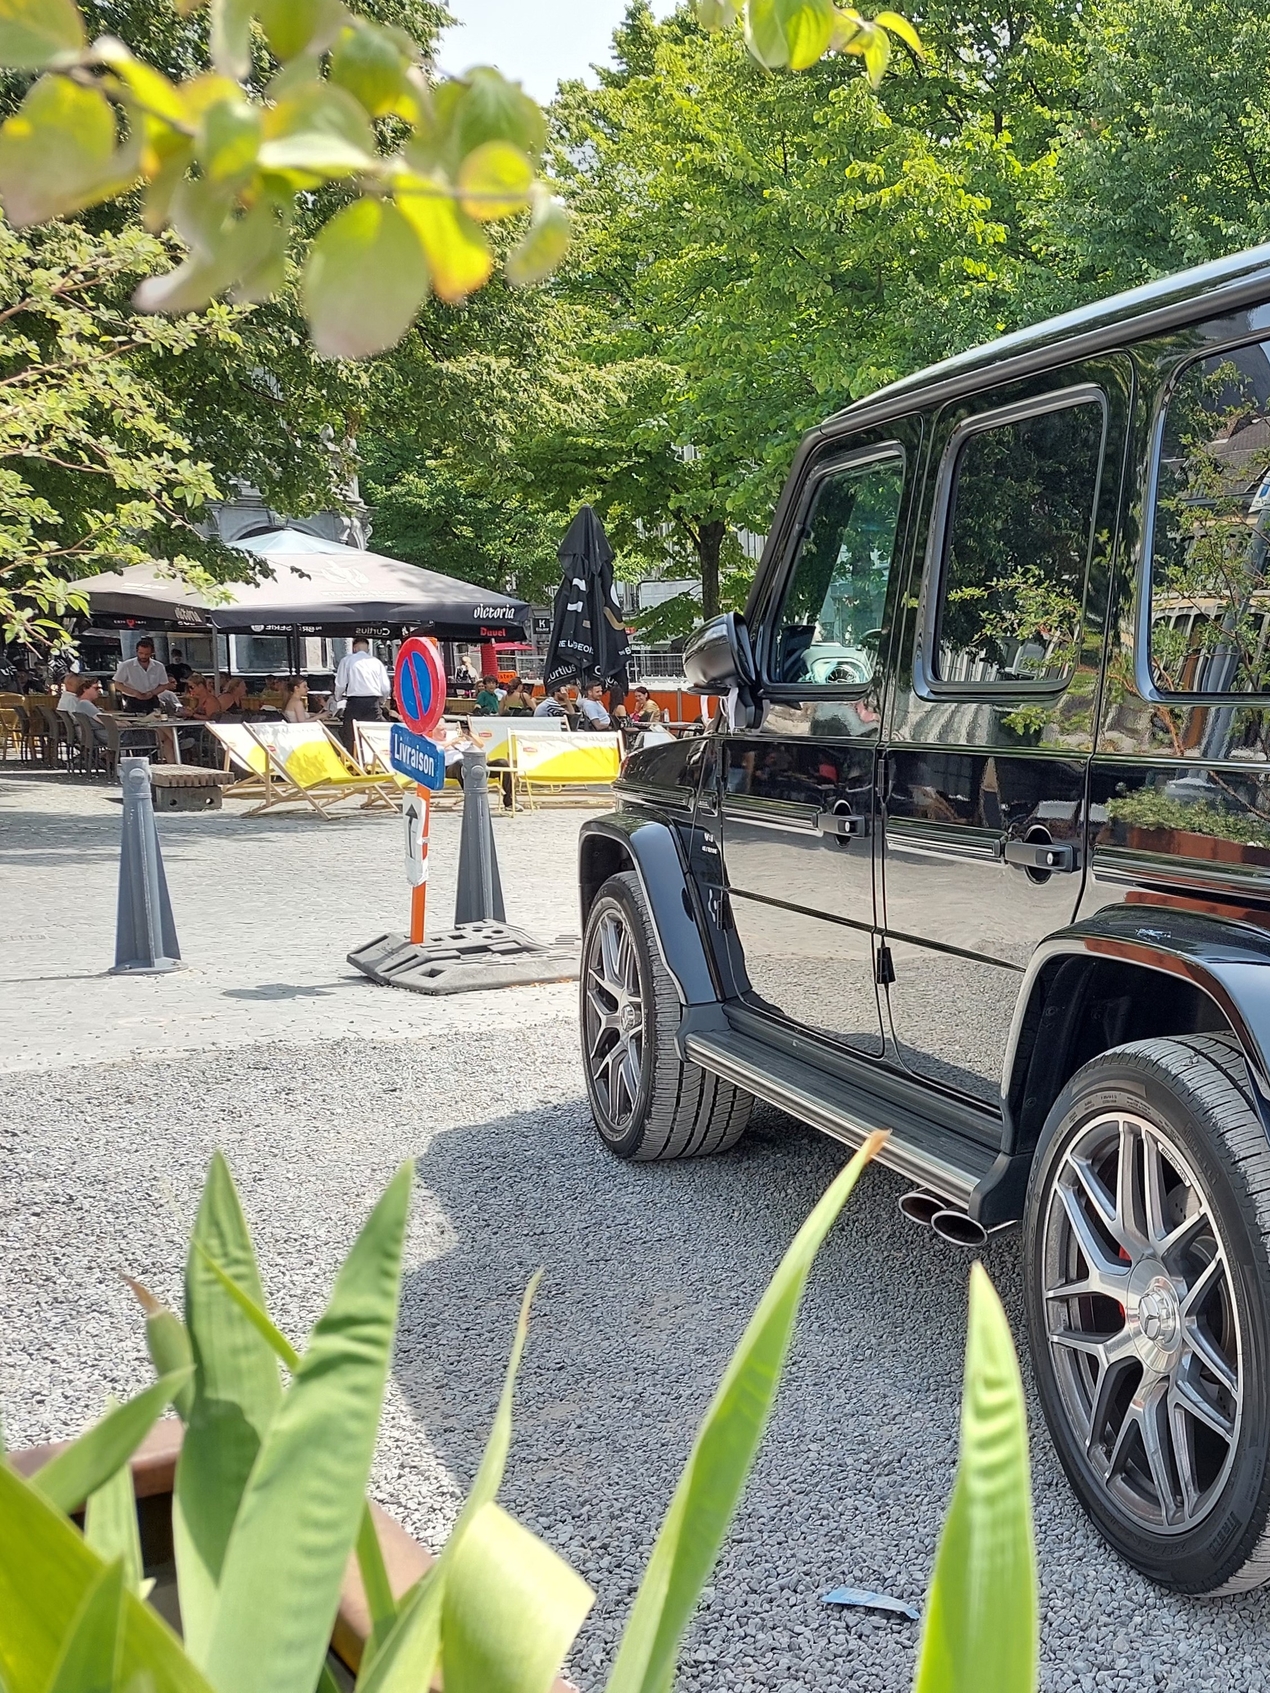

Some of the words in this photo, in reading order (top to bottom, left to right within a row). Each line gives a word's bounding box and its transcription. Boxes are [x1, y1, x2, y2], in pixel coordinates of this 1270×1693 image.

[473, 603, 515, 619] victoria
[480, 627, 506, 637] Duvel
[394, 733, 435, 777] Livraison
